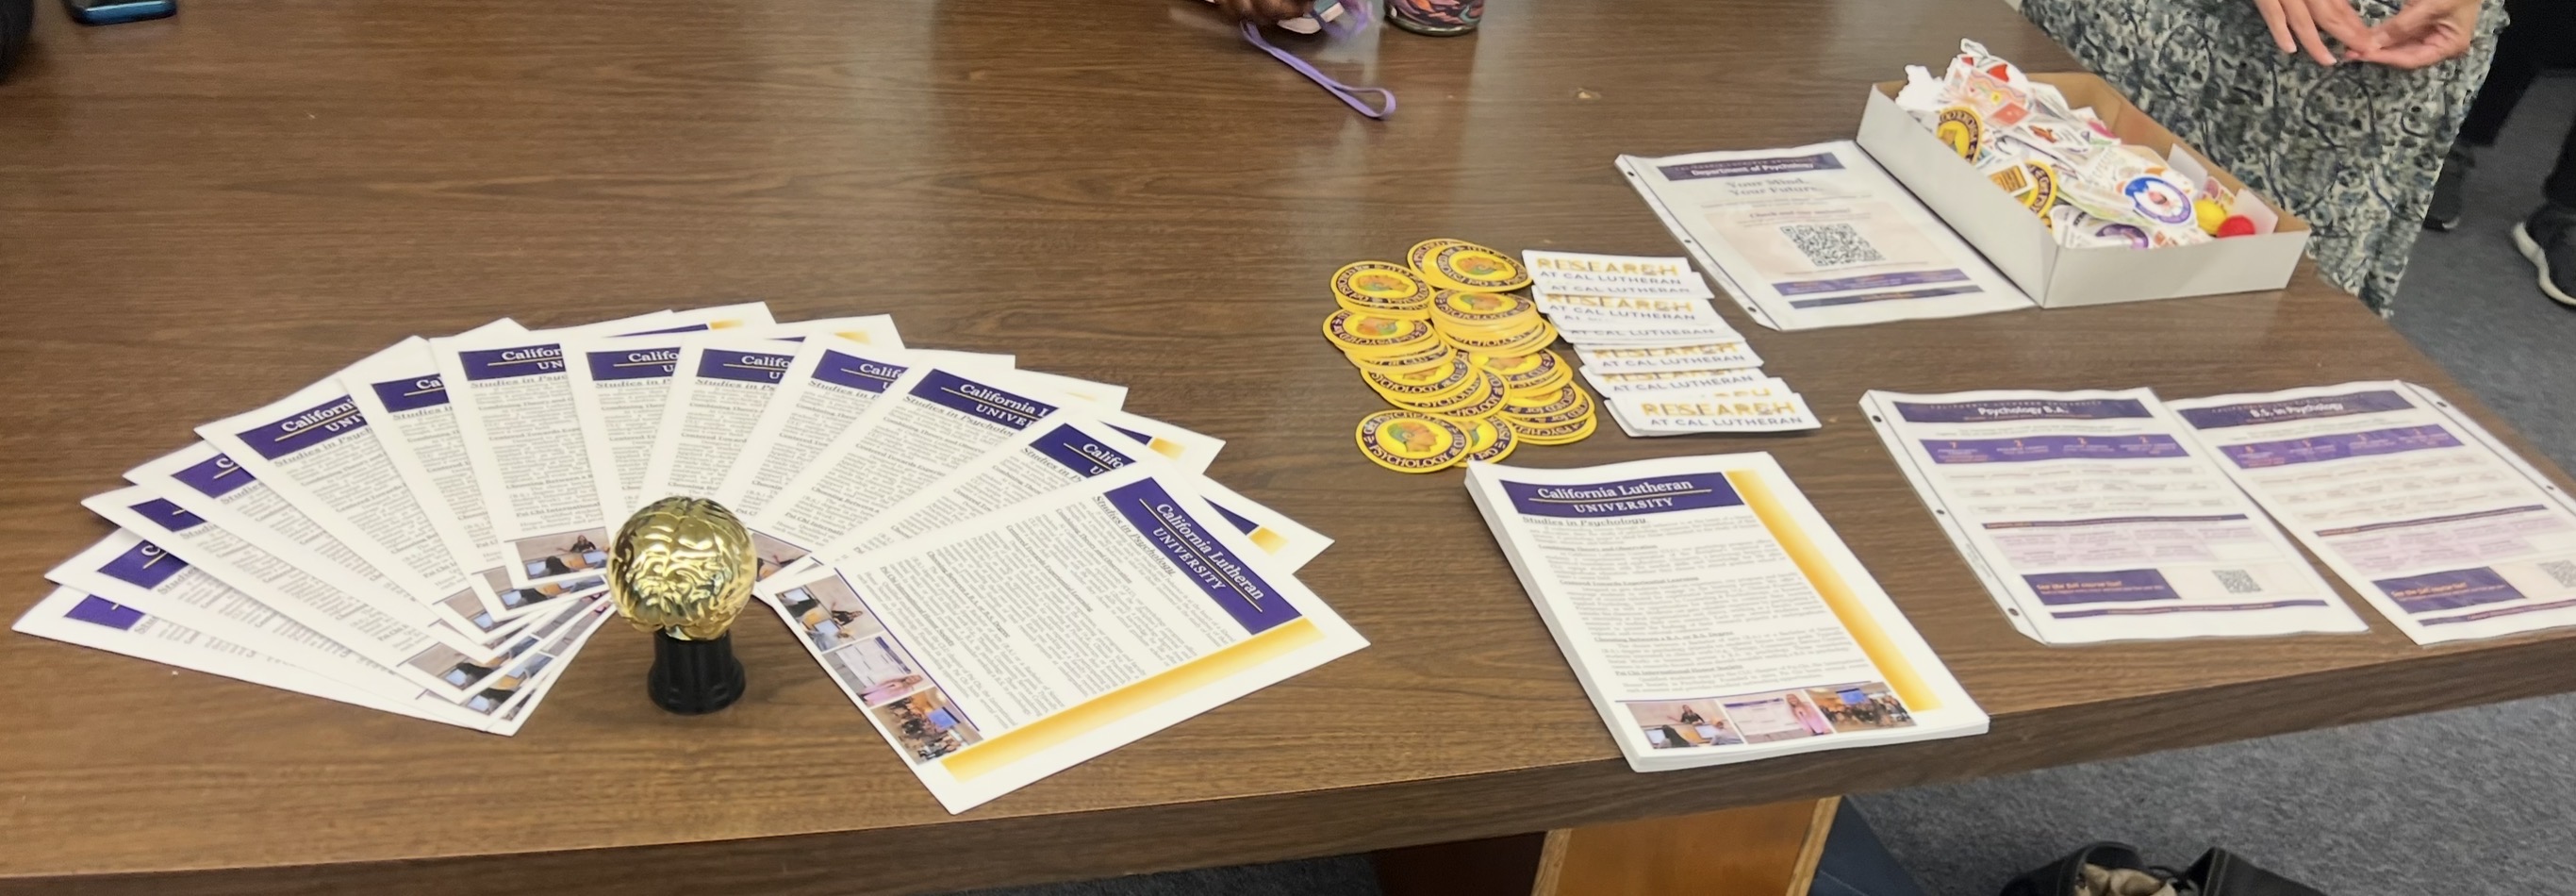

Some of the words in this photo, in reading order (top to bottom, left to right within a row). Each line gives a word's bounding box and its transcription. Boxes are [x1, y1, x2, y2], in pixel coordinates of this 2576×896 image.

[1691, 167, 1749, 176] Department
[1761, 162, 1814, 172] Psychology
[1536, 257, 1678, 275] RESEARCH
[1563, 272, 1592, 280] CAL
[1598, 274, 1681, 285] LUTHERAN
[1574, 285, 1599, 293] CAL
[1605, 286, 1691, 294] LUTHERAN
[1546, 294, 1694, 312] RESEARCH
[1549, 304, 1566, 312] AT
[1574, 307, 1600, 316] CAL
[1610, 309, 1695, 321] LUTHERAN
[1622, 327, 1715, 336] LUTHERAN
[502, 348, 562, 361] Califor
[628, 351, 678, 363] Califo
[741, 356, 791, 368] Califo
[1603, 359, 1619, 368] AT
[1626, 358, 1654, 367] CAL
[1660, 354, 1745, 366] LUTHERAN
[860, 363, 902, 378] Calif
[471, 379, 519, 389] Studies
[595, 380, 643, 389] Studies
[695, 378, 743, 390] Studies
[808, 380, 852, 395] Studies
[1370, 372, 1439, 393] SYCHOLOGY
[1613, 384, 1630, 392] AT
[1637, 381, 1664, 390] CAL
[1671, 375, 1753, 390] LUTHERAN
[960, 383, 1036, 417] California
[281, 397, 356, 433] Californi
[902, 395, 945, 410] Studies
[948, 408, 960, 417] in
[961, 413, 1015, 437] Psycholo
[976, 403, 1033, 427] UNIVE
[1641, 402, 1796, 417] RESEARCH
[1977, 407, 2042, 419] Psychology
[2042, 406, 2070, 414] B.A.
[2286, 403, 2343, 414] Psychology
[1676, 418, 1706, 426] CAL
[1711, 416, 1803, 425] LUTHERAN
[274, 449, 320, 468] Studies
[339, 427, 373, 444] Psych
[1021, 446, 1058, 472] Studies
[1082, 442, 1124, 470] Califo
[1369, 444, 1450, 469] PSYCHOLOGY
[1537, 488, 1617, 500] California
[1618, 480, 1693, 496] Lutheran
[1574, 497, 1673, 514] UNIVERSITY
[1522, 516, 1563, 524] Studies
[1580, 519, 1646, 528] Psychology
[180, 524, 218, 540] Studi
[1091, 495, 1127, 523] Studies
[1119, 523, 1135, 533] in
[1127, 532, 1179, 575] Psychology
[1149, 526, 1227, 591] UNIVERSITY
[1152, 503, 1217, 554] California
[1206, 551, 1268, 600] Lutheran
[157, 567, 197, 596] Studie
